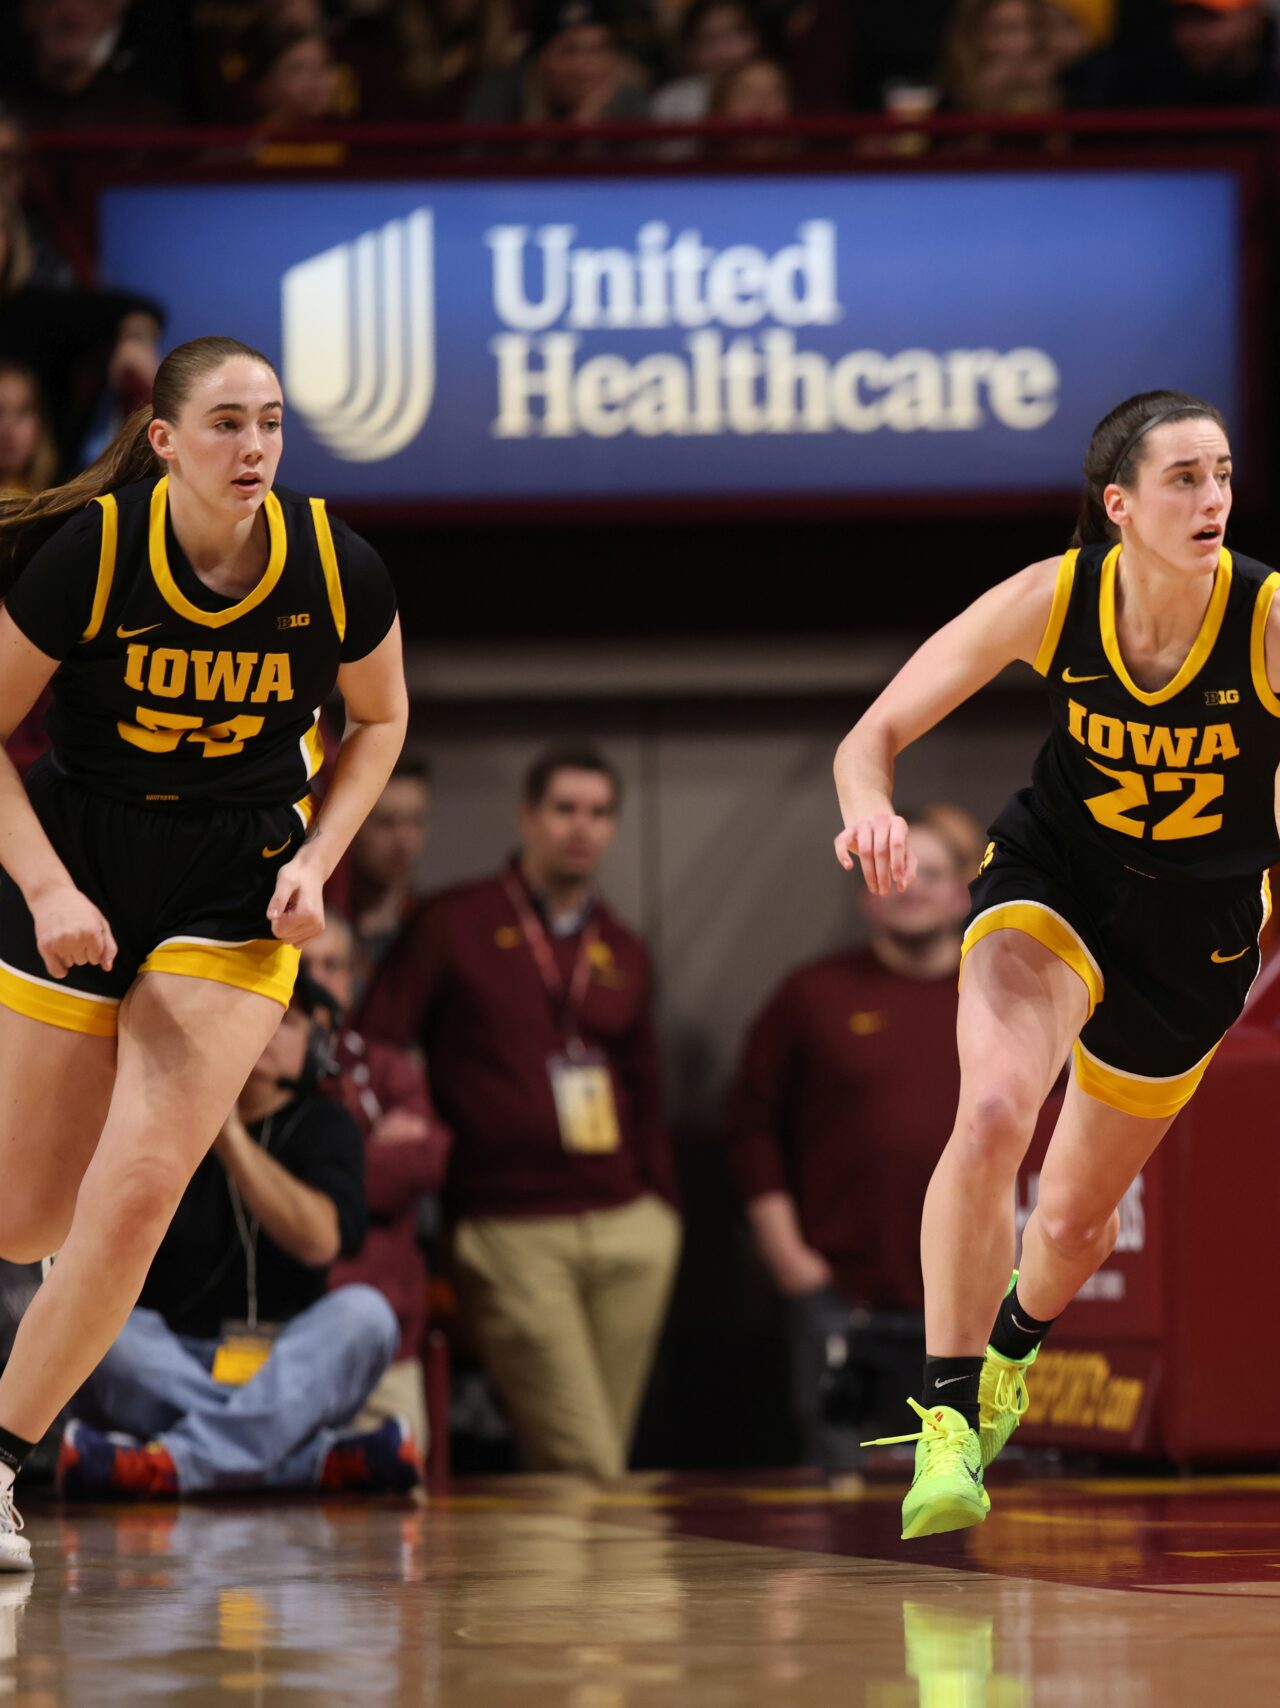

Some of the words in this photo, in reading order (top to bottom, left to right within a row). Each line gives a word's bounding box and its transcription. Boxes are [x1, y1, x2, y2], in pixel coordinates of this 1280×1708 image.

[486, 219, 842, 331] United
[490, 328, 1059, 438] Healthcare
[124, 643, 294, 702] IOWA
[1068, 697, 1240, 768] IOWA
[1083, 756, 1225, 841] 22
